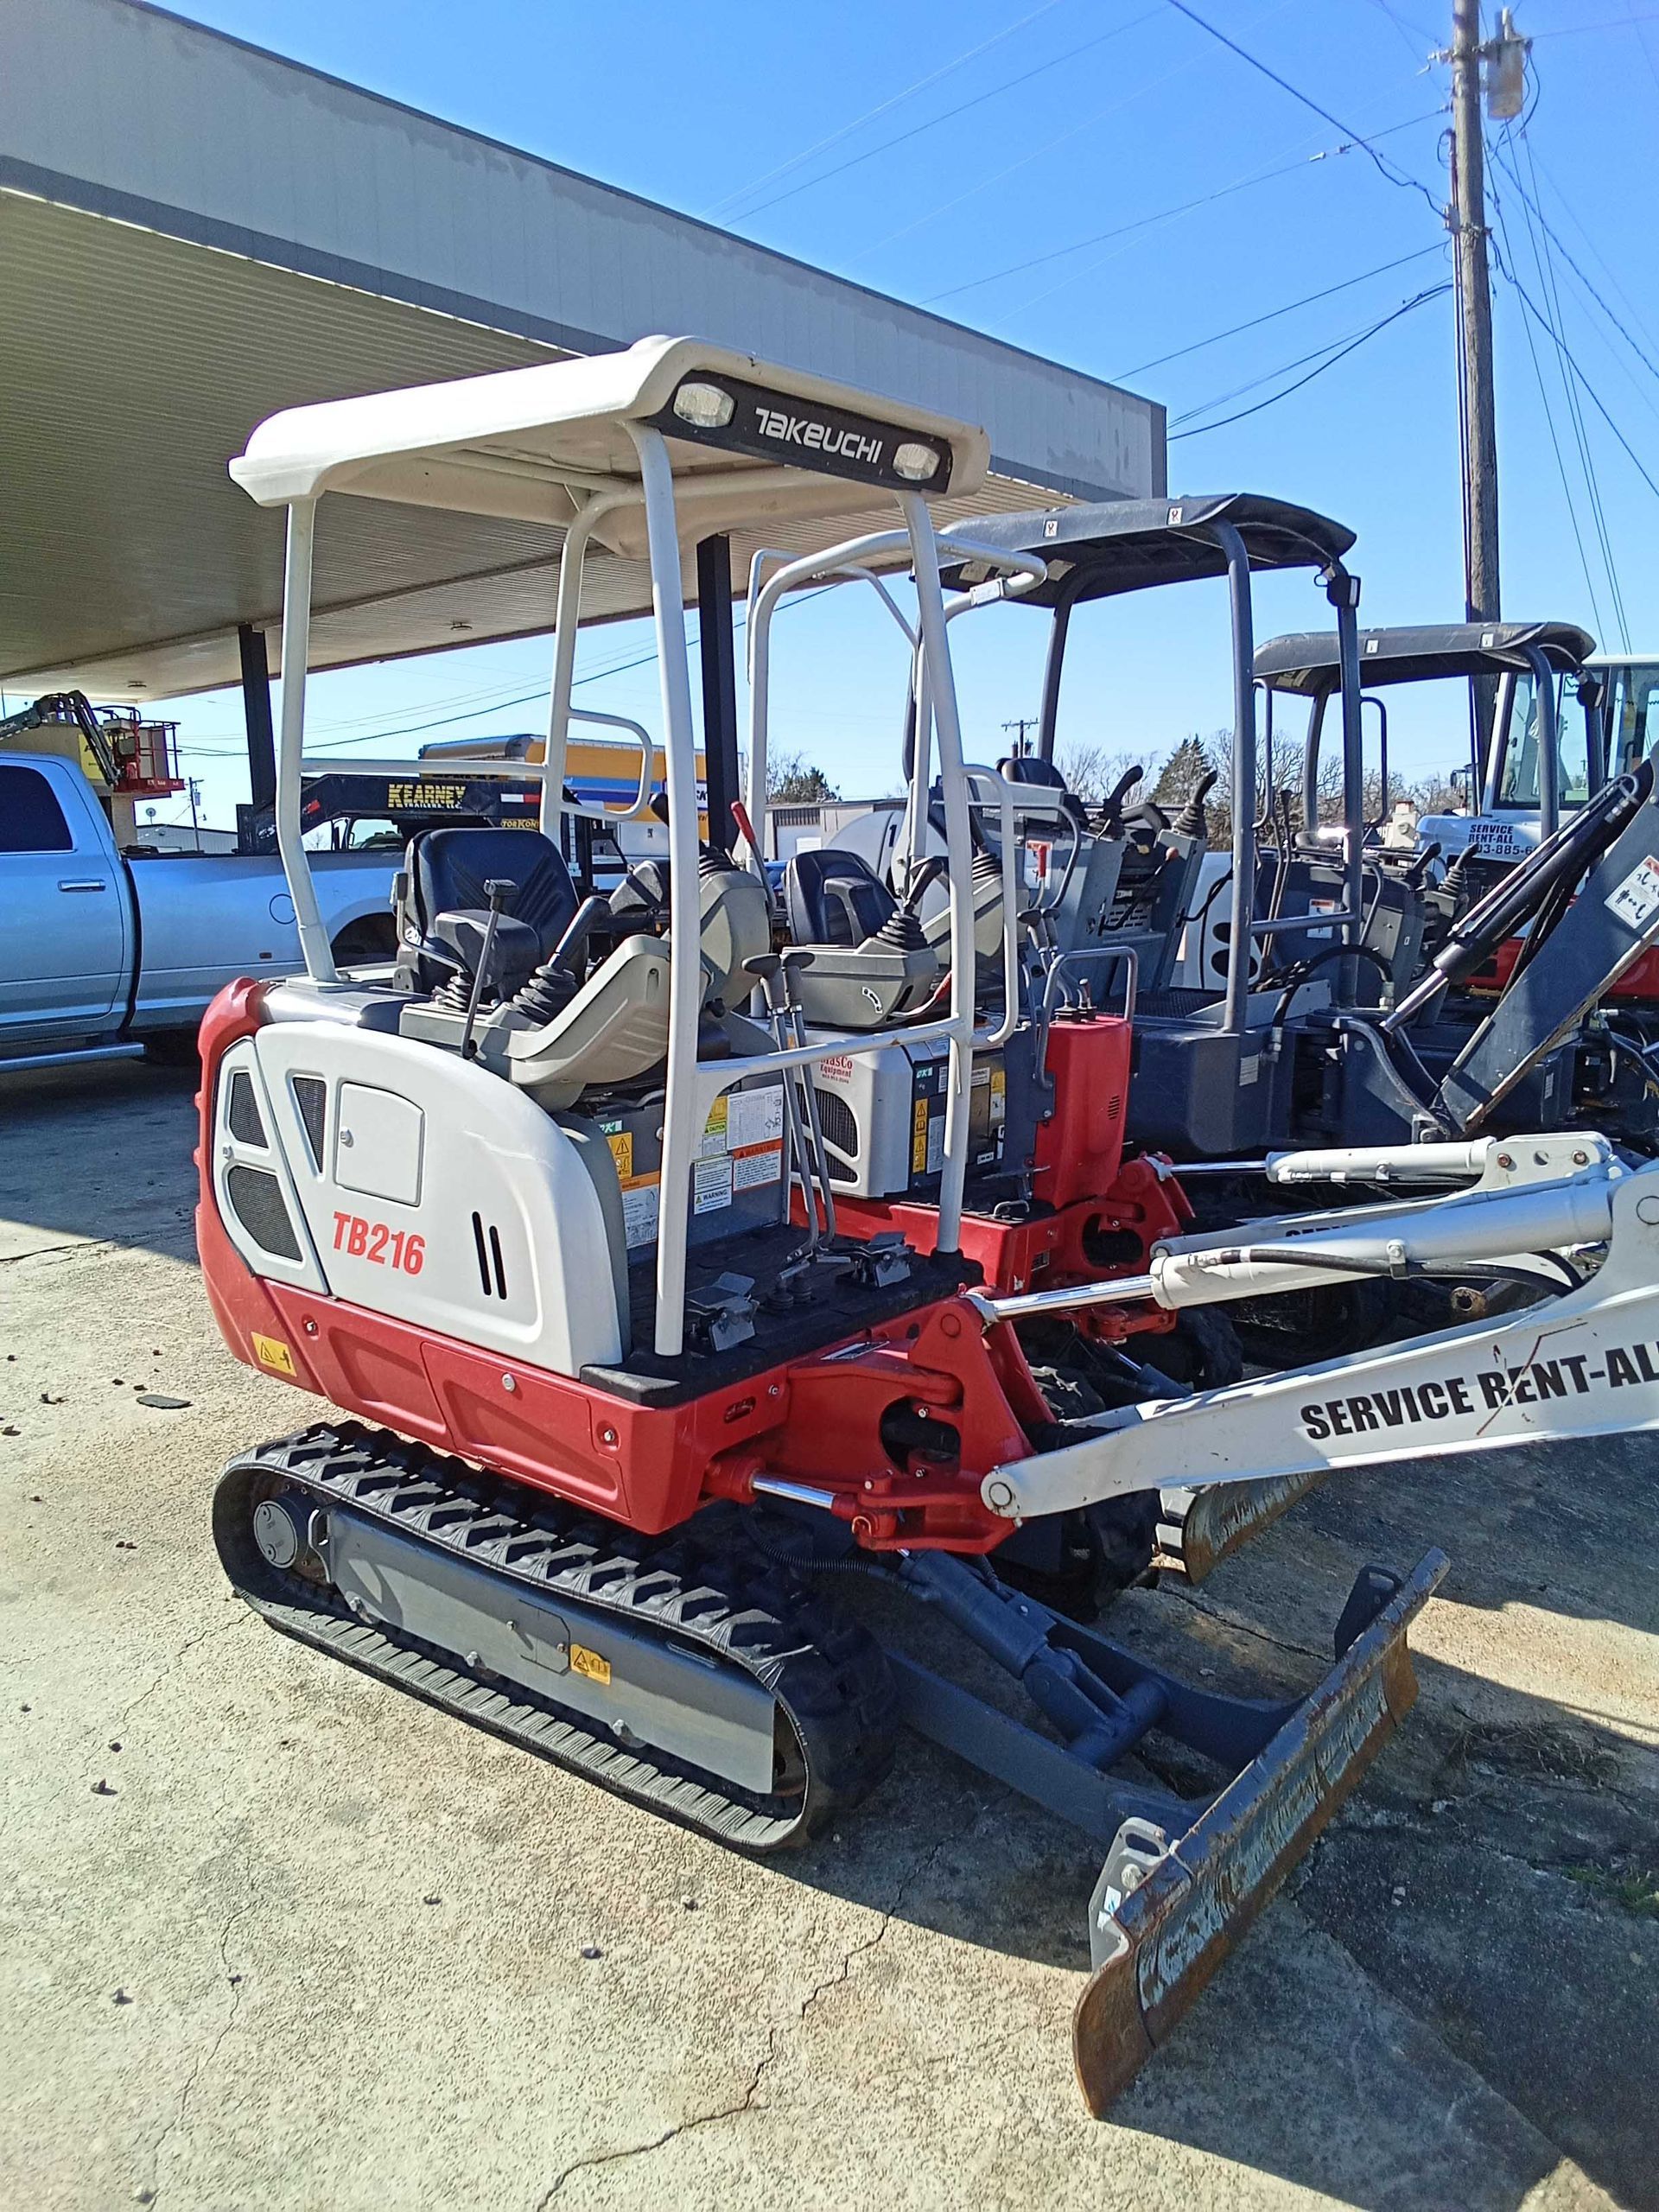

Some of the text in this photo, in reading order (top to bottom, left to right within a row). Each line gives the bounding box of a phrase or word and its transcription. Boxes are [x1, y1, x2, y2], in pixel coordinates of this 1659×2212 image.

[388, 784, 467, 808] KEARNEY
[1470, 824, 1514, 834] SERVICE
[1469, 834, 1514, 844] RENT-ALL
[820, 1064, 852, 1077] Equipment
[703, 1189, 728, 1200] WARNING
[334, 1211, 425, 1274] TB216
[1300, 1341, 1659, 1440] SERVICE RENT-AL
